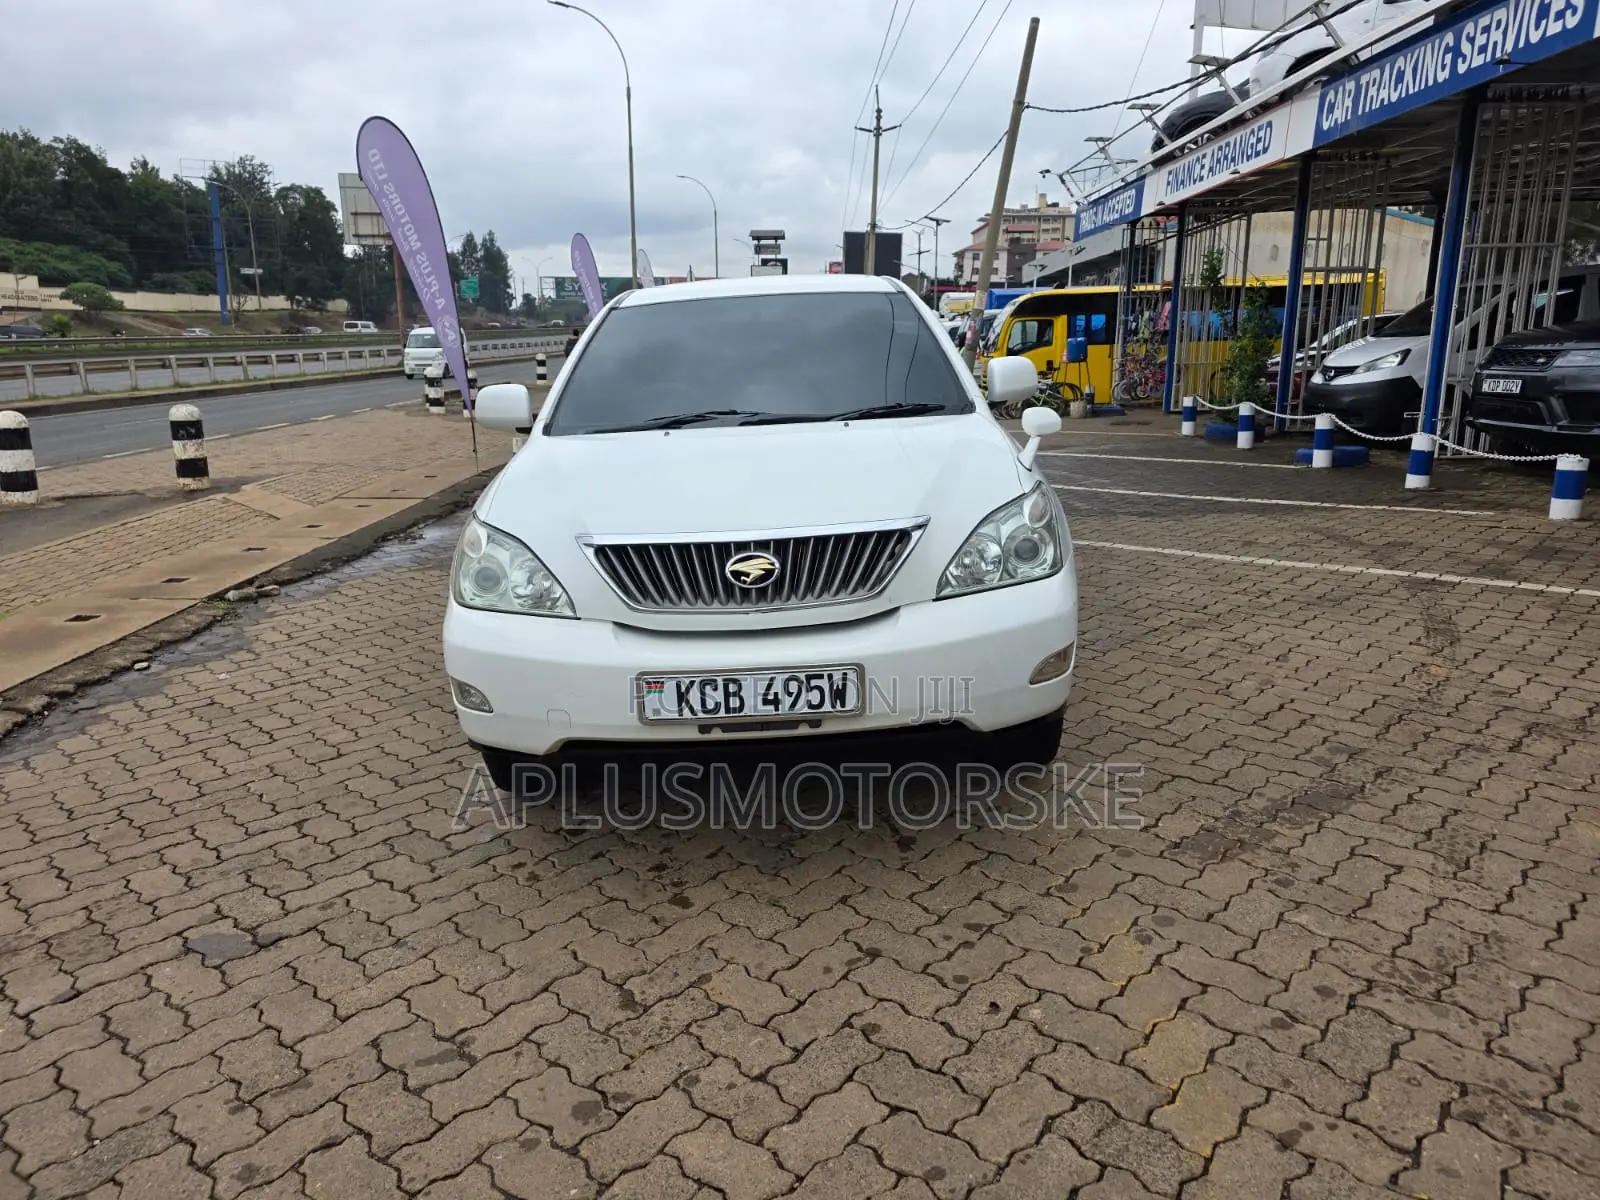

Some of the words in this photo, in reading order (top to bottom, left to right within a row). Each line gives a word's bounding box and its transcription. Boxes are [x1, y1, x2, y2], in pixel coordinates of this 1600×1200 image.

[1322, 81, 1353, 131] CAR
[1358, 31, 1454, 116] TRACKING
[1457, 0, 1584, 75] SERVICES
[1165, 152, 1208, 197] FINANCE
[1206, 120, 1273, 179] ARRANGED
[1102, 188, 1136, 225] ACCEPTED
[675, 677, 746, 717] KCB
[761, 671, 849, 713] 495W
